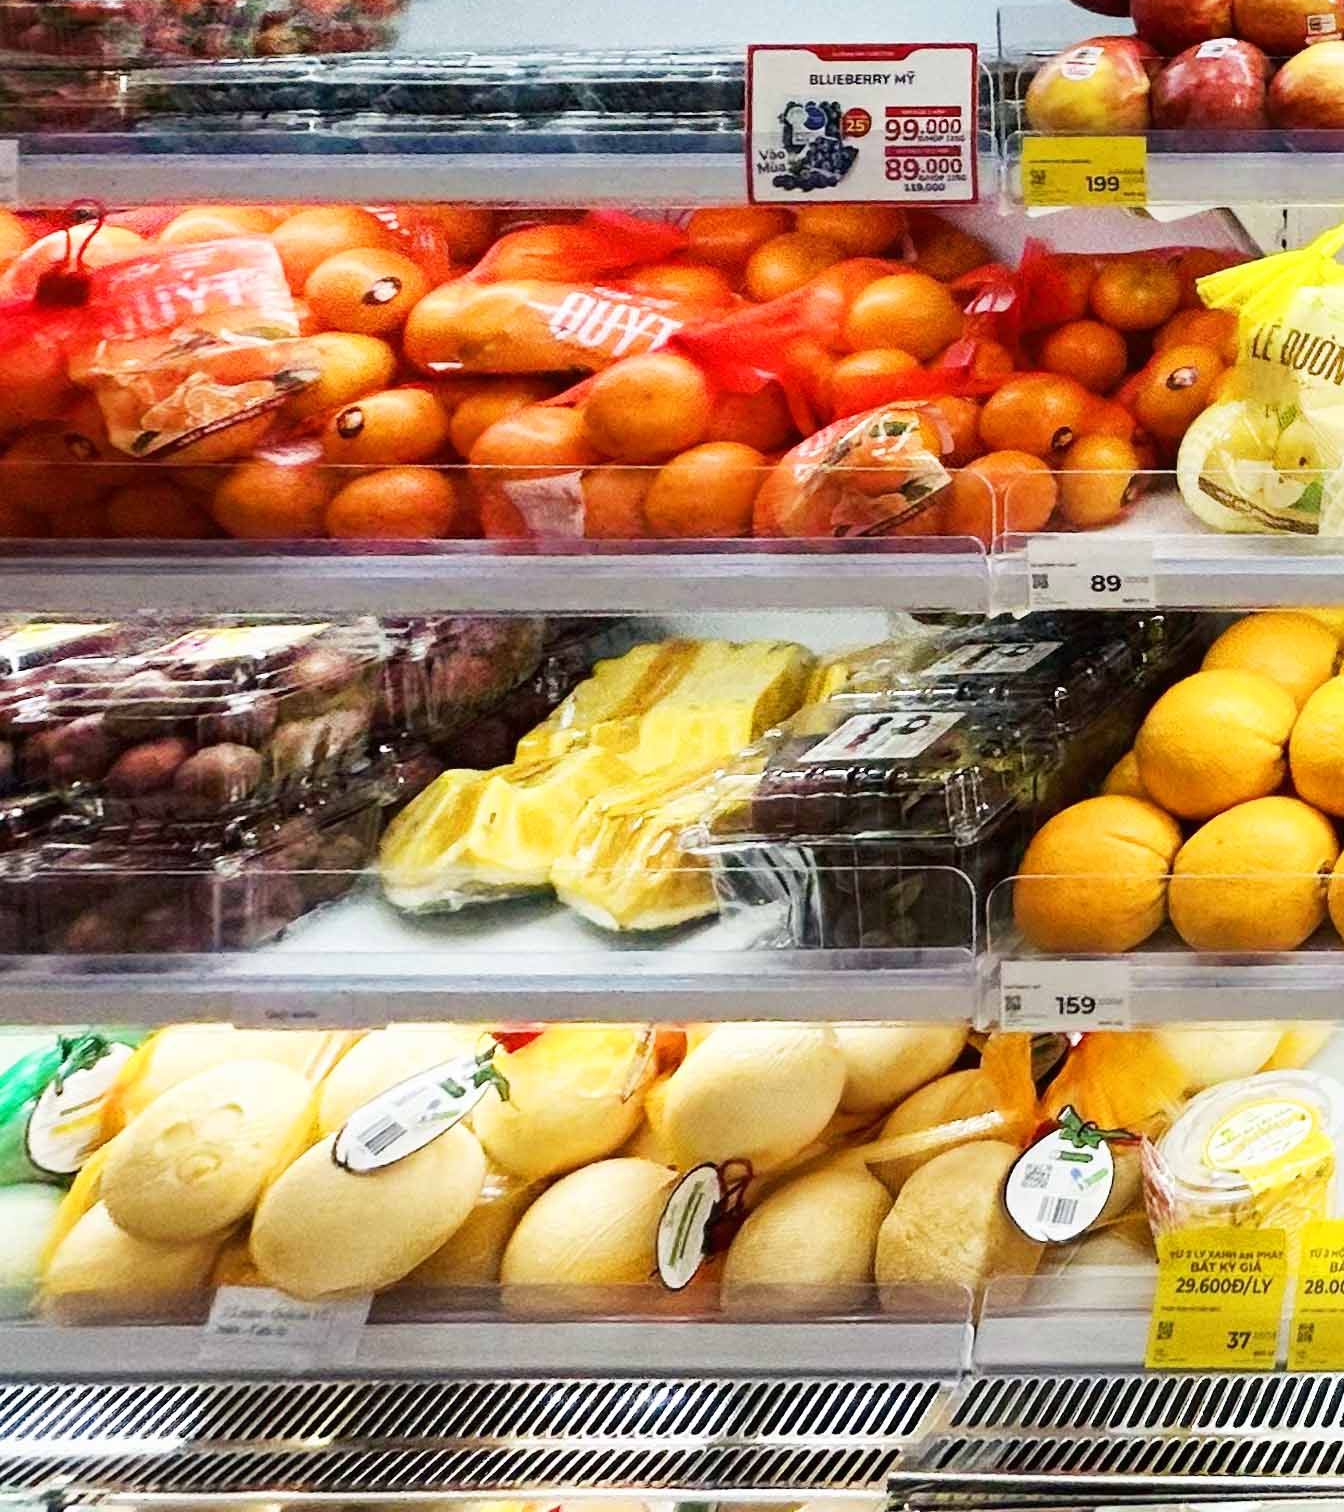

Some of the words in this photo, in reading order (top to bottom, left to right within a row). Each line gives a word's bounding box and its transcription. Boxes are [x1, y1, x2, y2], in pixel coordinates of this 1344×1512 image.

[809, 73, 891, 86] BLUEBERRY
[894, 70, 916, 86] MỸ
[846, 119, 866, 133] 25
[885, 118, 962, 142] 99.000
[758, 149, 785, 161] Vào
[757, 162, 786, 174] Mùa
[885, 158, 963, 181] 89.000
[904, 183, 946, 193] 119.000
[1086, 175, 1121, 192] 199
[1090, 574, 1122, 593] 89
[1055, 996, 1096, 1015] 159
[1239, 1260, 1262, 1273] GIÁ
[1175, 1275, 1273, 1296] 29.600Đ/LY
[1226, 1331, 1252, 1349] 37
